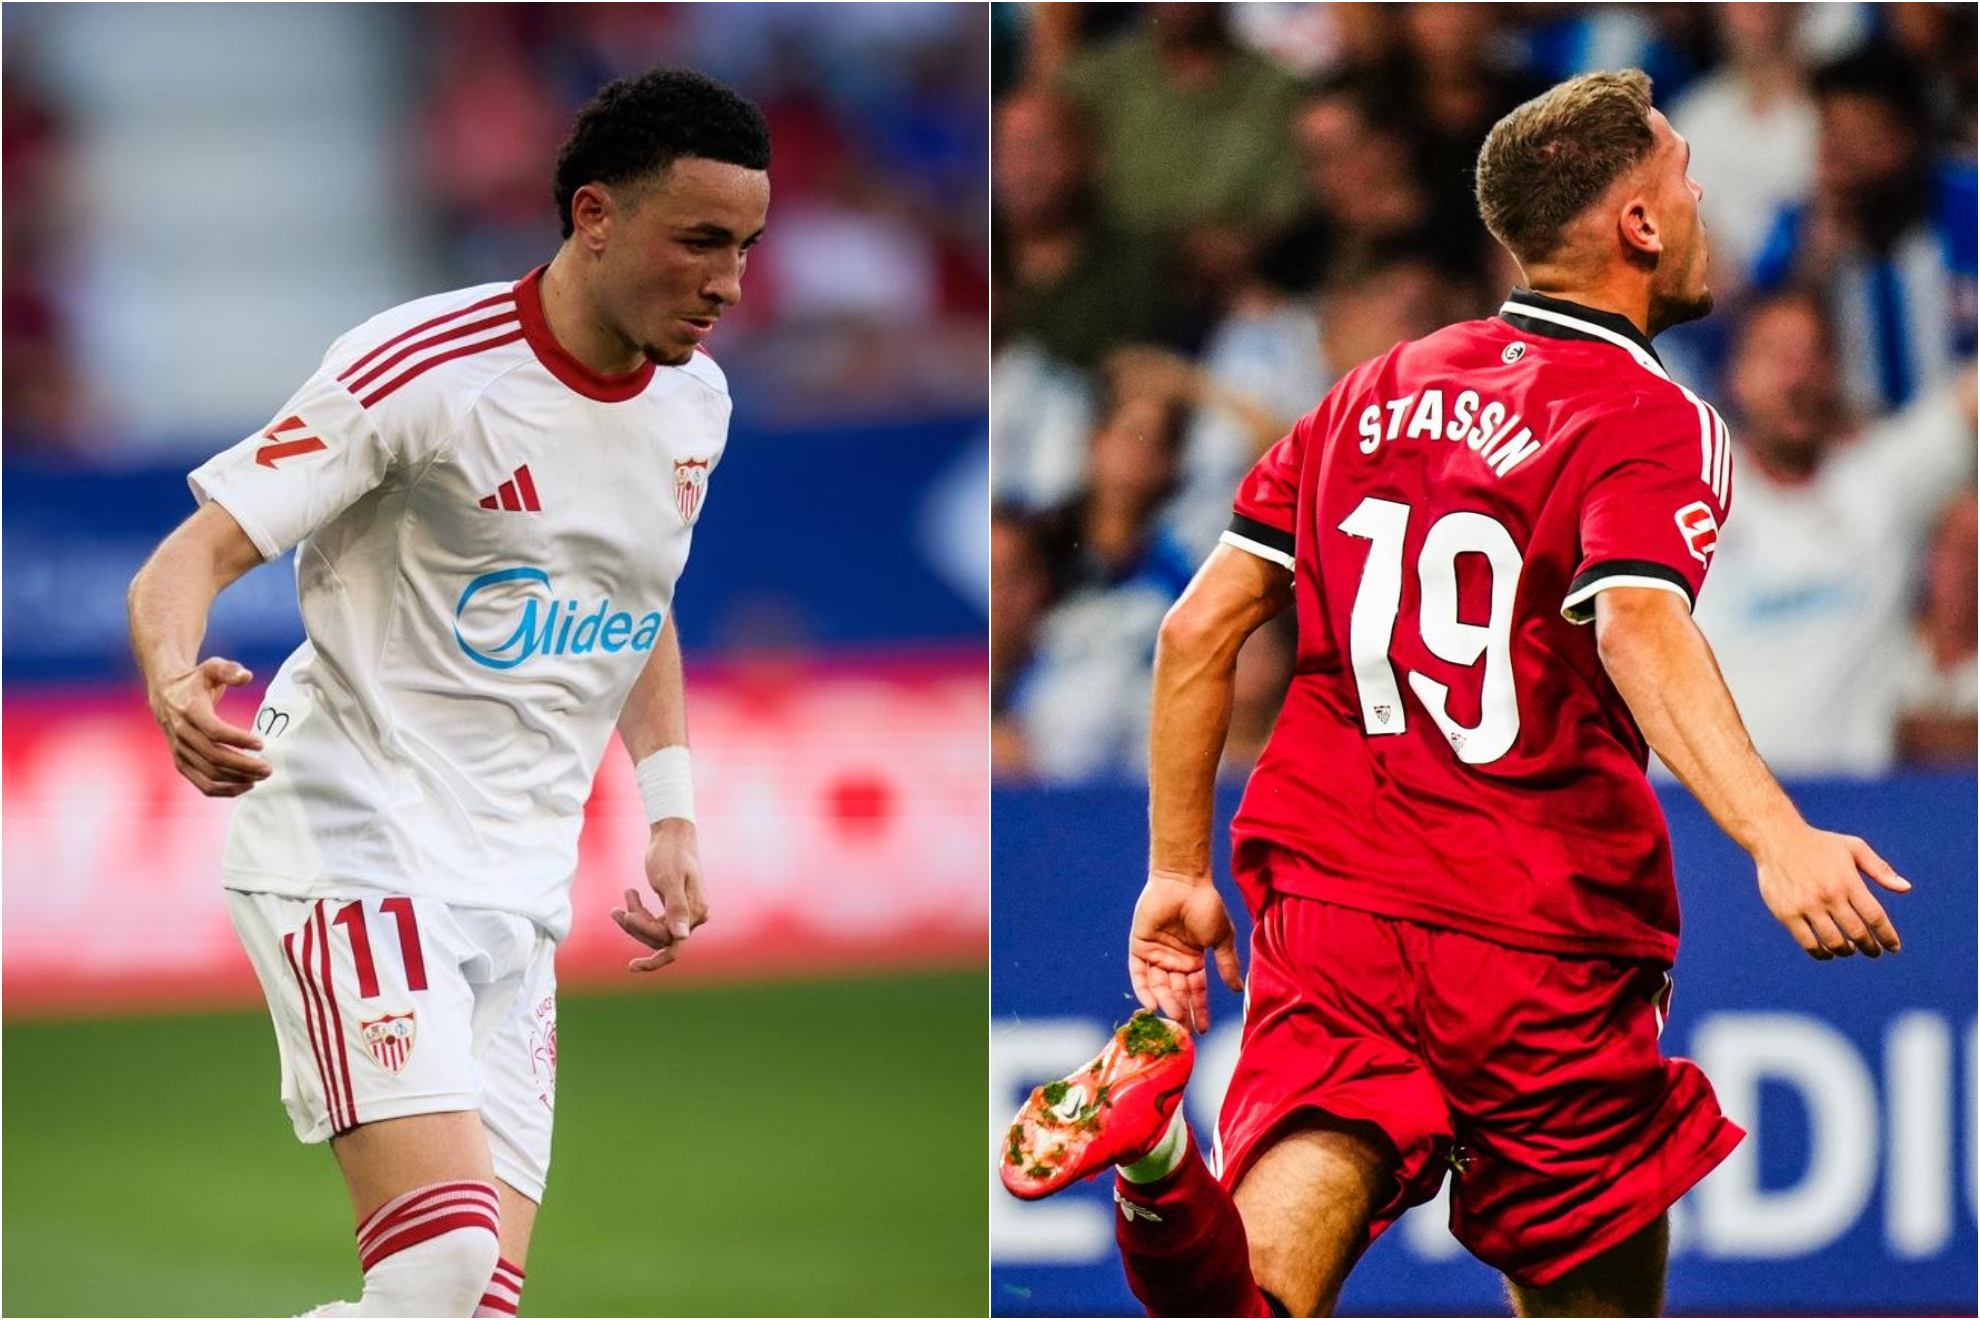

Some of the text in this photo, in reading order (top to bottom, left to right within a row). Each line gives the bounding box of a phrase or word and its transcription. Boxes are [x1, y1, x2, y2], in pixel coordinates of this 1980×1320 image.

[1358, 389, 1542, 479] STASSIN
[452, 566, 662, 669] Midea
[1337, 496, 1523, 764] 19
[332, 897, 428, 999] 11
